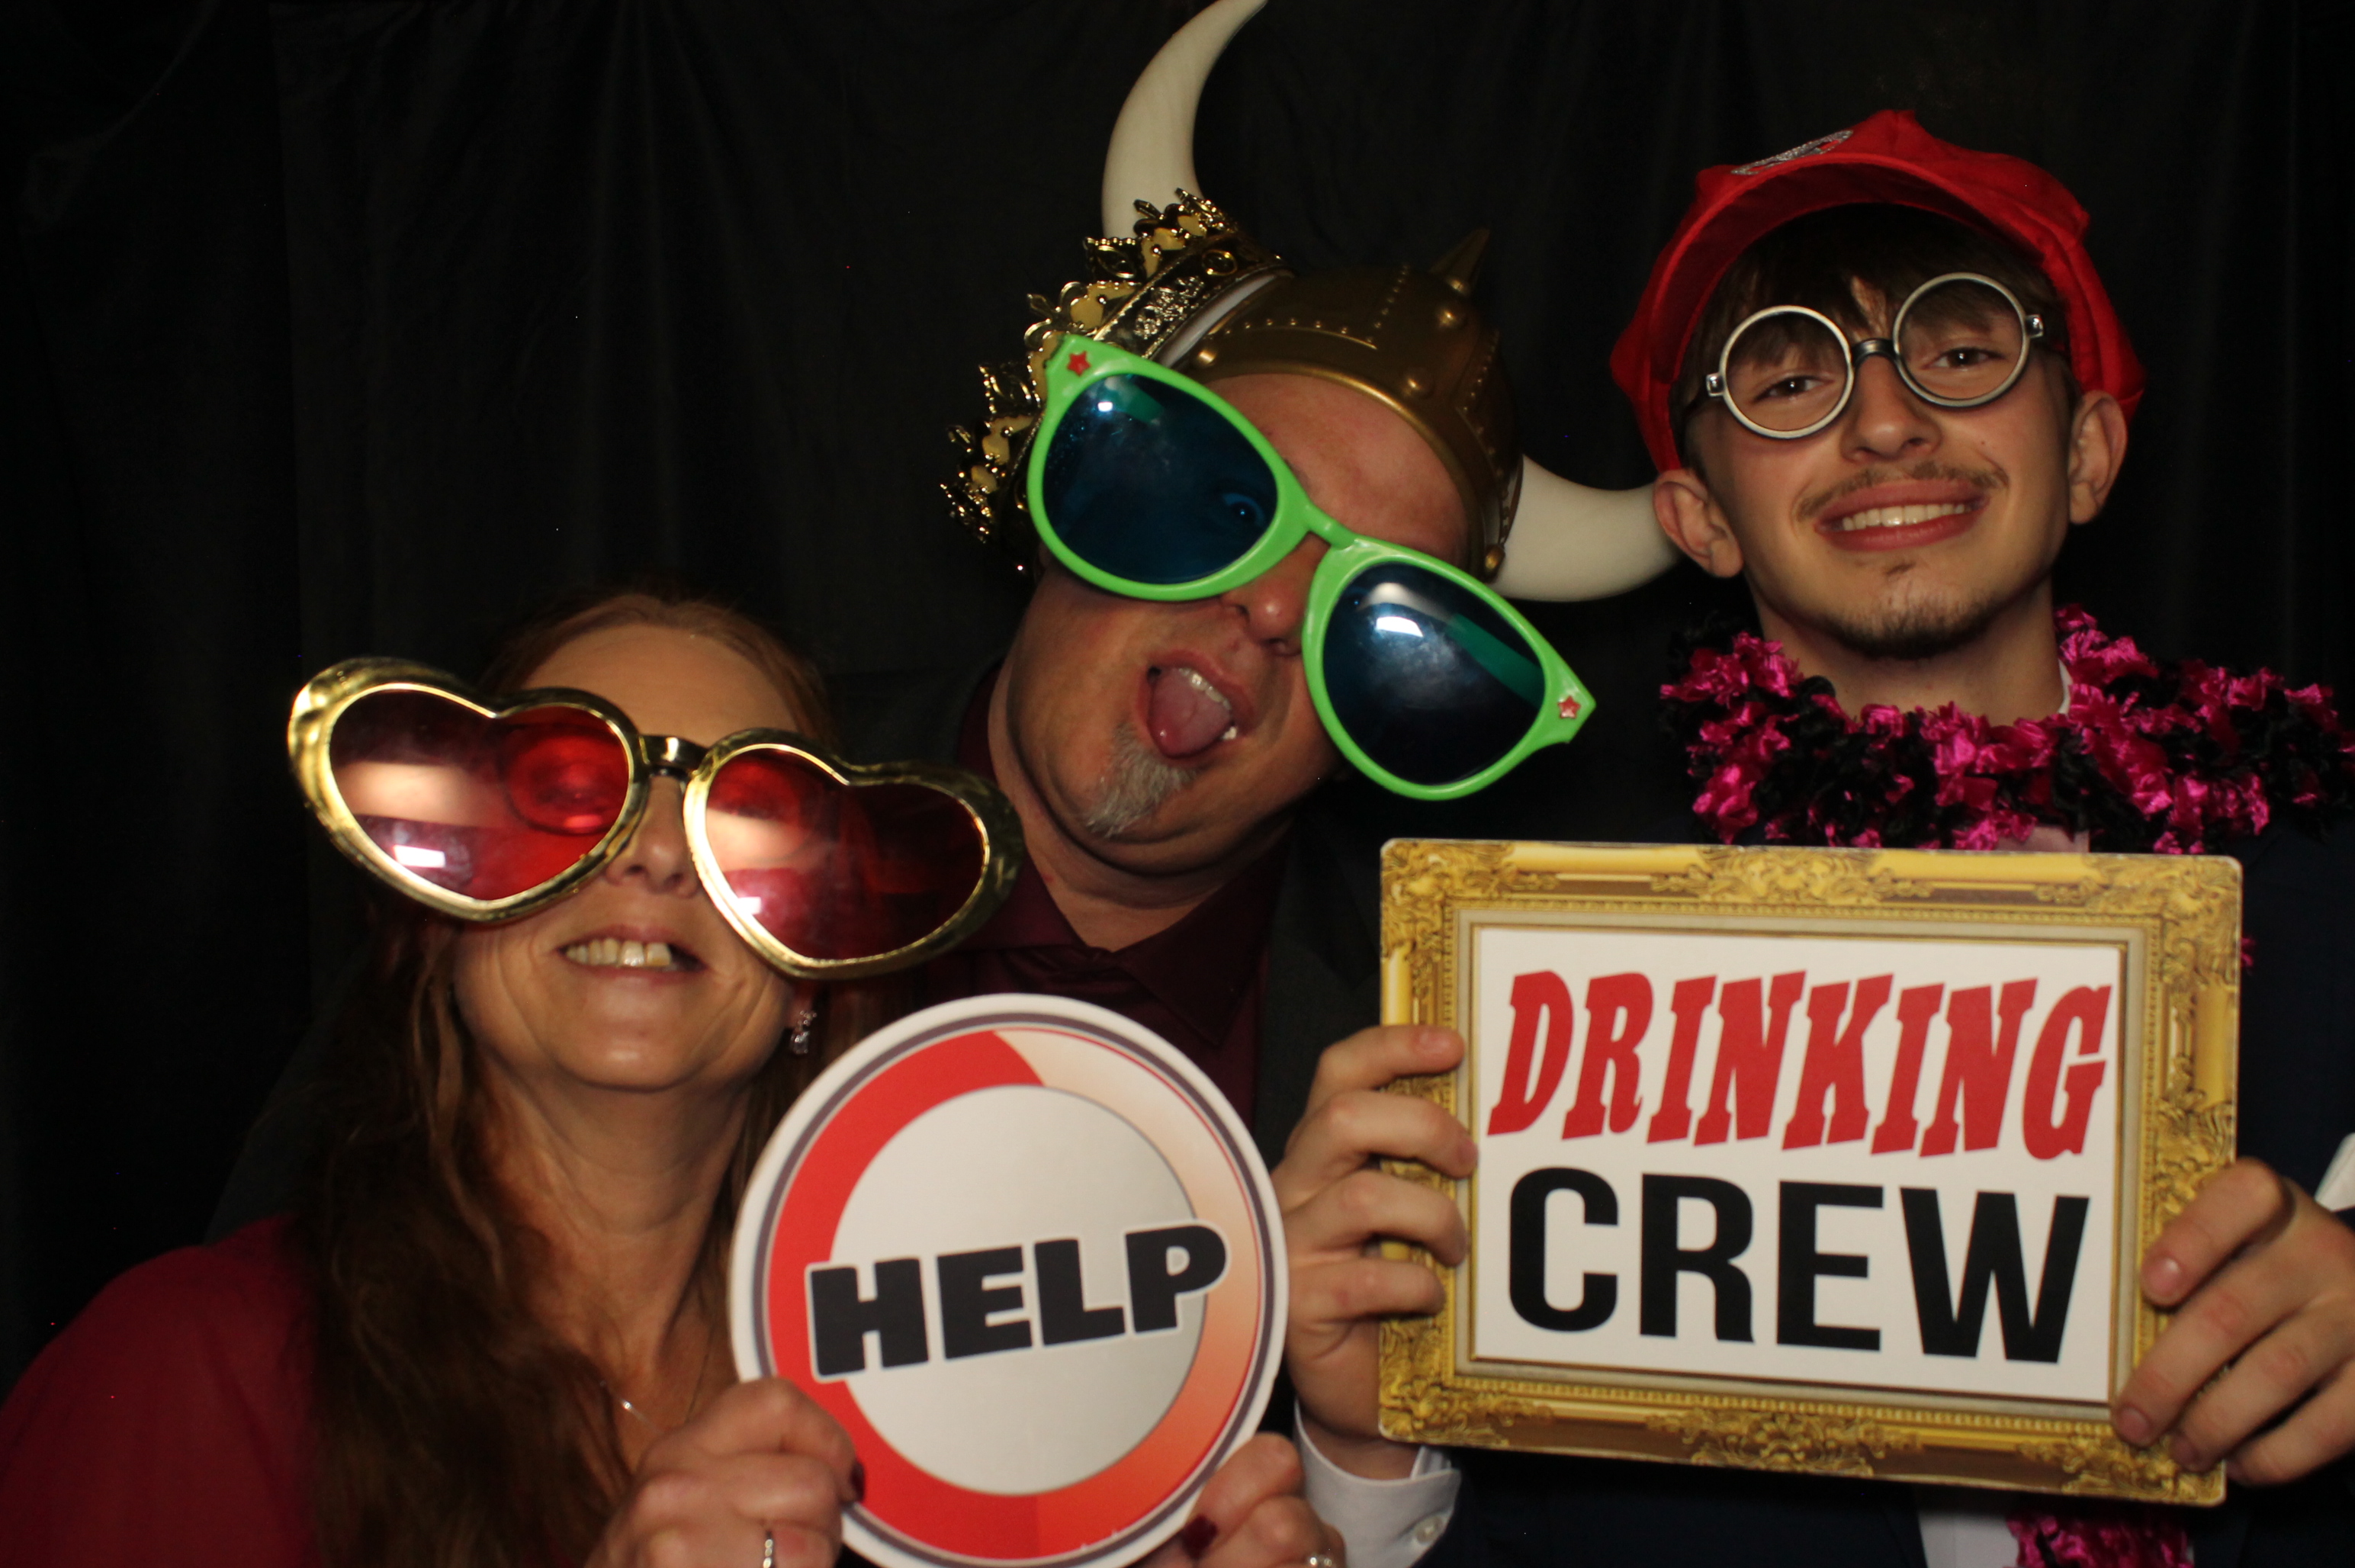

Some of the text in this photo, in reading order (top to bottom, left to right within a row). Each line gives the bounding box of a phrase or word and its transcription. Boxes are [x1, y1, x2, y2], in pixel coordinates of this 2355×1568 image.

[1486, 970, 2112, 1160] DRINKING
[810, 1225, 1227, 1376] HELP
[1508, 1167, 2090, 1364] CREW
